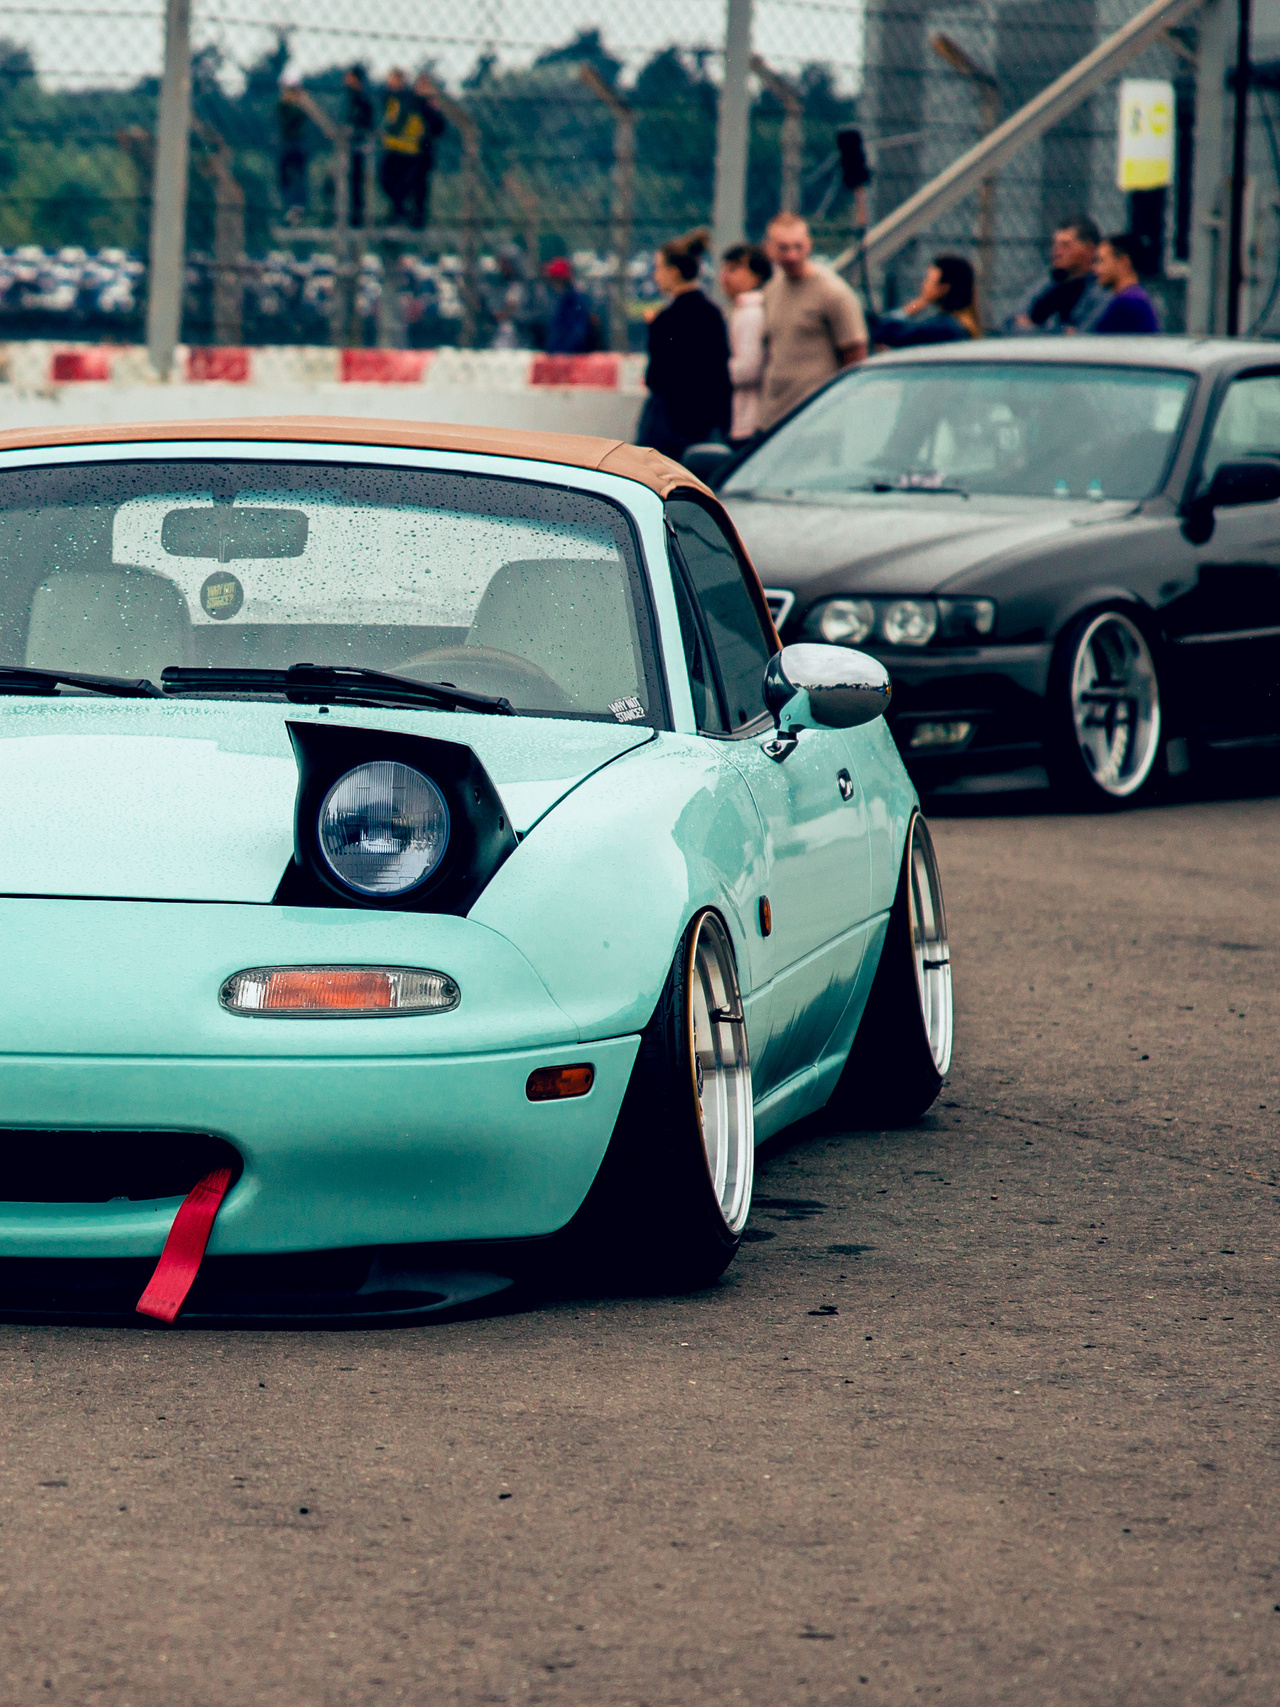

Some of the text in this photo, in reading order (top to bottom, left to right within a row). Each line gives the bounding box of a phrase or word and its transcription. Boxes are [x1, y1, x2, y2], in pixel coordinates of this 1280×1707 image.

[608, 700, 627, 713] WHY
[625, 697, 641, 709] NOT
[615, 706, 646, 723] STANCE?
